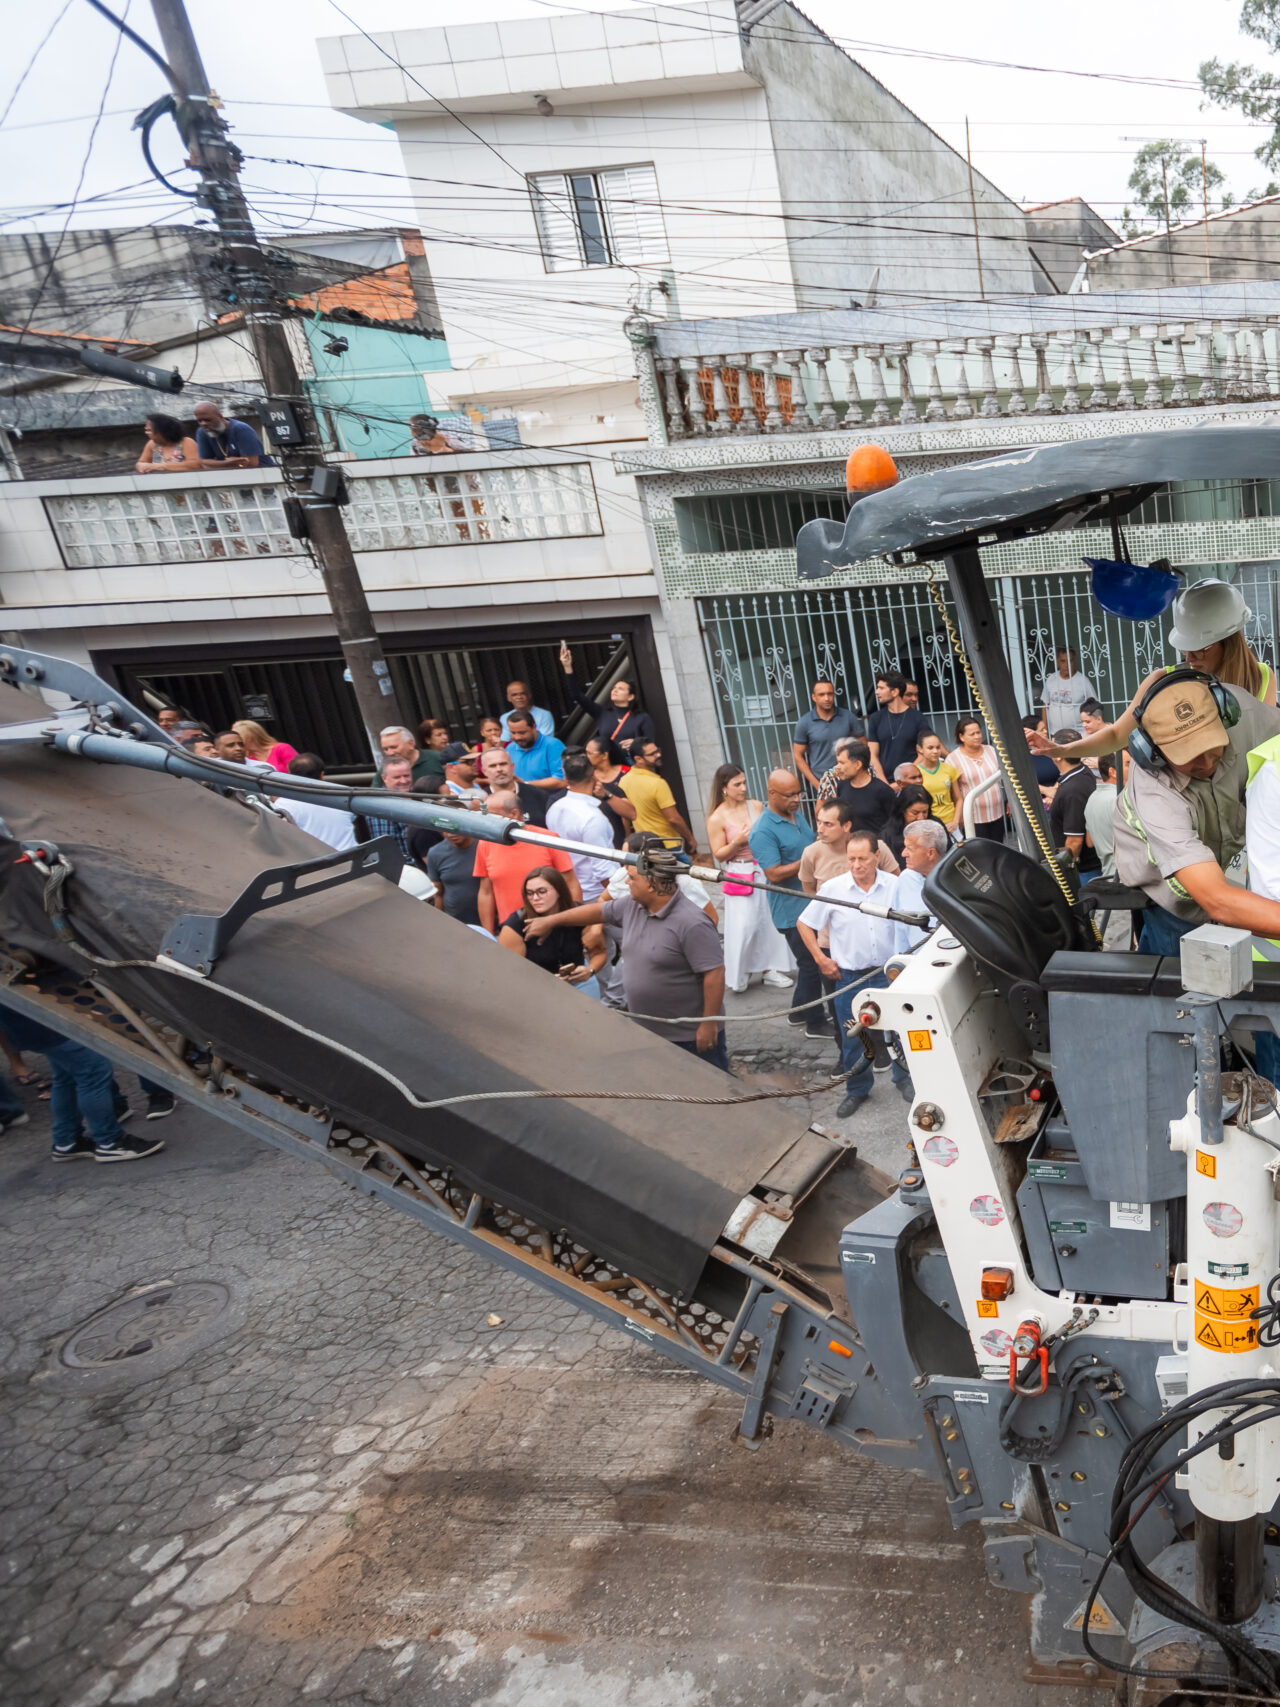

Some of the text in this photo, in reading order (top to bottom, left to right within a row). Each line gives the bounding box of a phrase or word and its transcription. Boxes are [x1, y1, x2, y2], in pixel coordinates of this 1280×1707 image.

[270, 411, 286, 421] PN
[1175, 714, 1206, 732] JOHN DEERE
